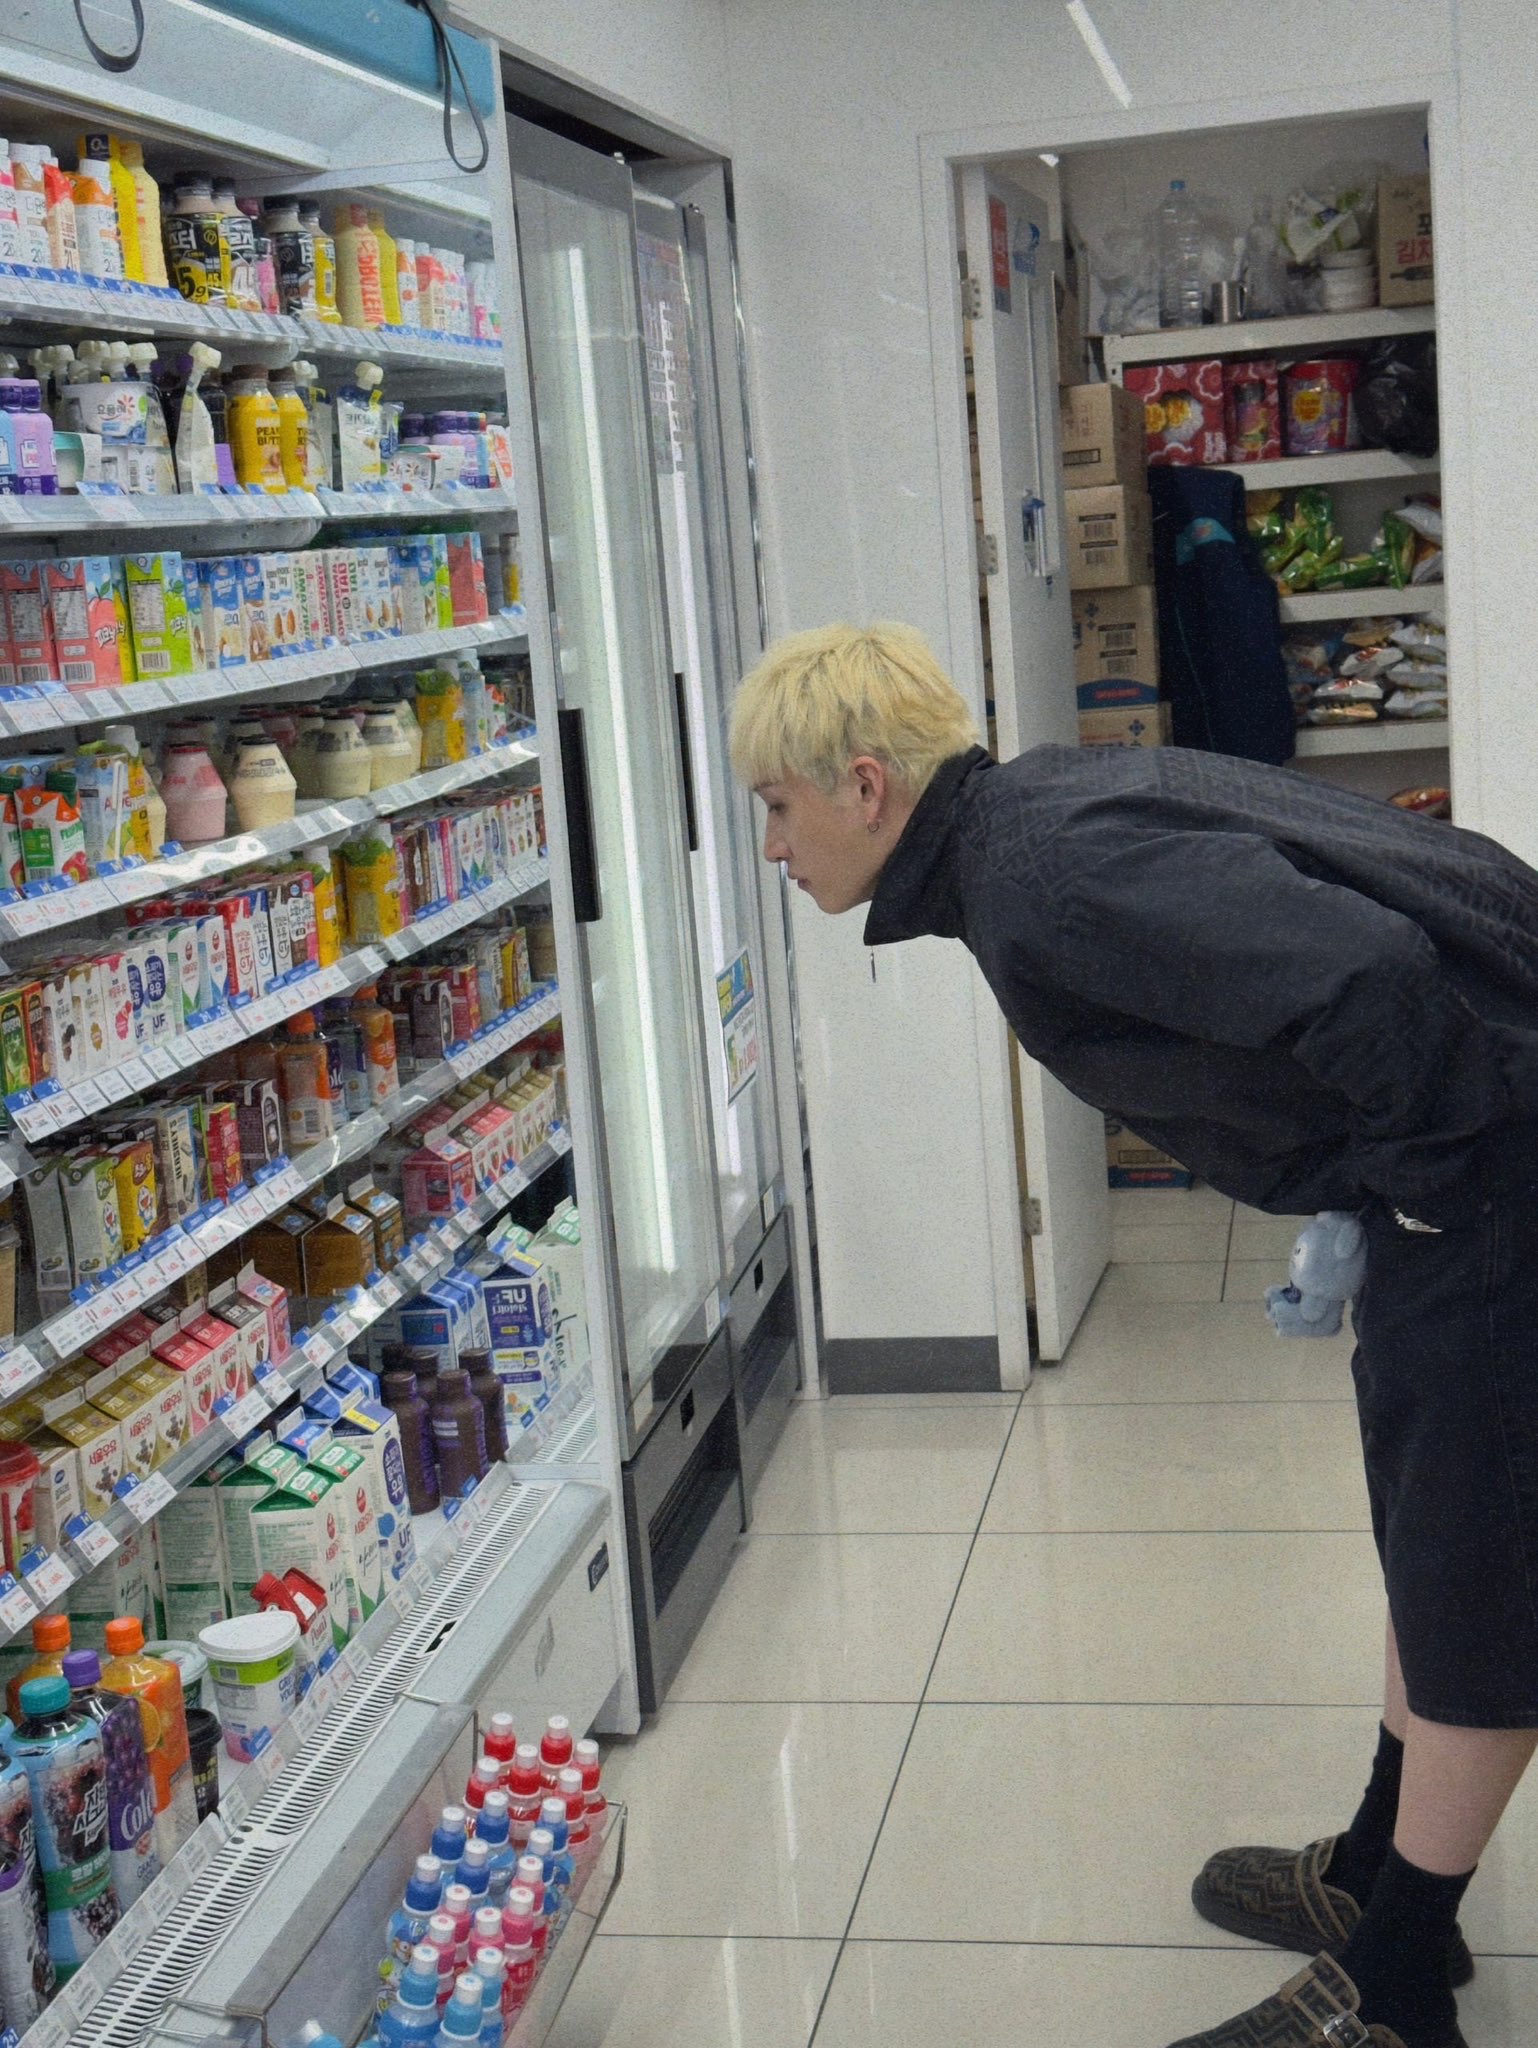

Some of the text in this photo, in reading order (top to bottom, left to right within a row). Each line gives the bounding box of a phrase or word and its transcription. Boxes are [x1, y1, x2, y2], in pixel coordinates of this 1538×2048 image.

[256, 426, 279, 436] PEA
[256, 437, 280, 446] BUTT
[298, 567, 310, 640] AMAZIN
[316, 564, 330, 633] AMAZIN
[149, 979, 162, 997] 우유
[152, 1013, 166, 1029] UF
[391, 1474, 404, 1499] 우유
[398, 1522, 411, 1549] UF
[1, 1573, 17, 1591] 2+1
